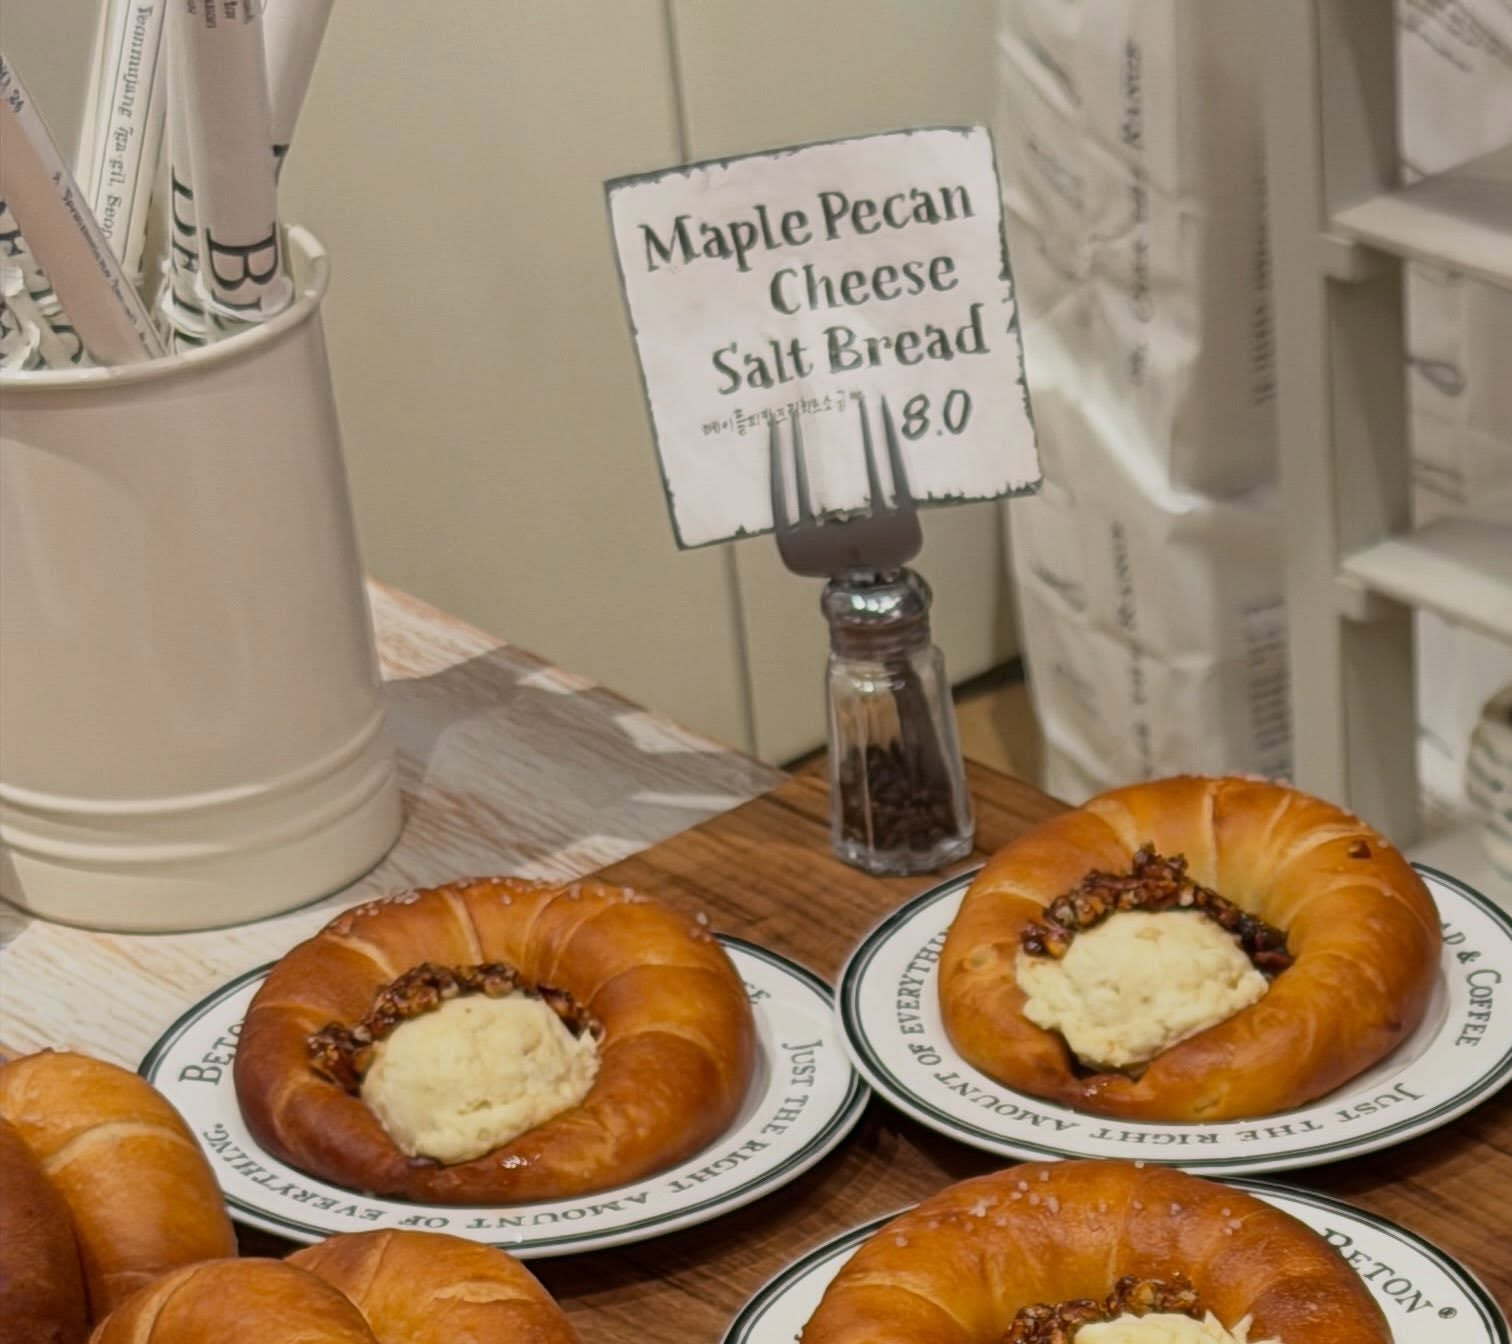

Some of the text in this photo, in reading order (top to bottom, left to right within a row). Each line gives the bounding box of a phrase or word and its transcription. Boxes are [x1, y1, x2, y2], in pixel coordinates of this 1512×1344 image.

[637, 184, 976, 273] Maple Pecan
[769, 254, 960, 315] Cheese
[711, 302, 992, 396] Salt Bread
[900, 388, 972, 441] 8.0
[1455, 969, 1502, 1047] COFFEE
[178, 1017, 246, 1086] BETO
[781, 1039, 824, 1087] JUST
[908, 1043, 942, 1066] OF
[760, 1094, 809, 1135] THE
[933, 1072, 1081, 1131] AMOUNT
[1337, 1082, 1425, 1123] JUST
[1089, 1127, 1218, 1145] RIGHT
[1234, 1119, 1325, 1142] THE
[667, 1139, 771, 1194] RIGHT
[397, 1215, 450, 1229] OF
[465, 1191, 649, 1229] AMOUNT
